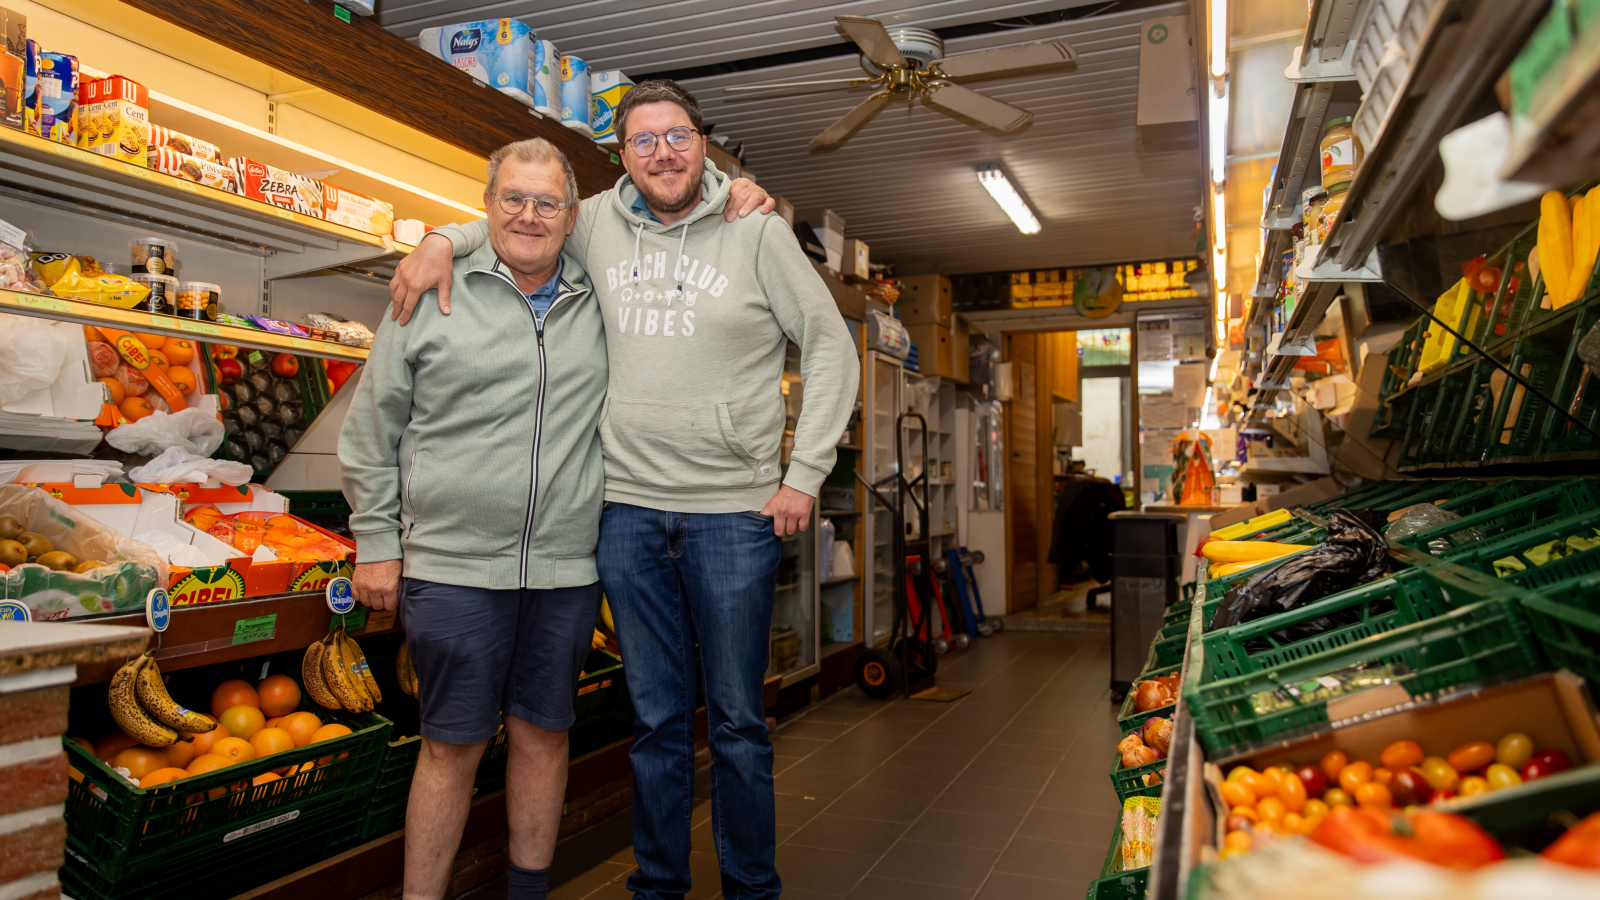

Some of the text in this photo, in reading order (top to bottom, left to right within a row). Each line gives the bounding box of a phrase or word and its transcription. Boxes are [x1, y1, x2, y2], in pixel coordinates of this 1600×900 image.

[452, 36, 480, 50] Nalys
[501, 31, 508, 39] 6
[453, 56, 478, 70] ABSORB
[88, 83, 97, 99] LU
[103, 79, 112, 95] LU
[122, 79, 138, 104] LU
[88, 103, 102, 112] Cent
[103, 100, 118, 108] Cent
[125, 106, 145, 121] Cent
[260, 179, 303, 202] ZEBRA
[325, 185, 337, 203] LU
[606, 251, 730, 298] BEACH CLUB
[618, 307, 696, 338] VIBES
